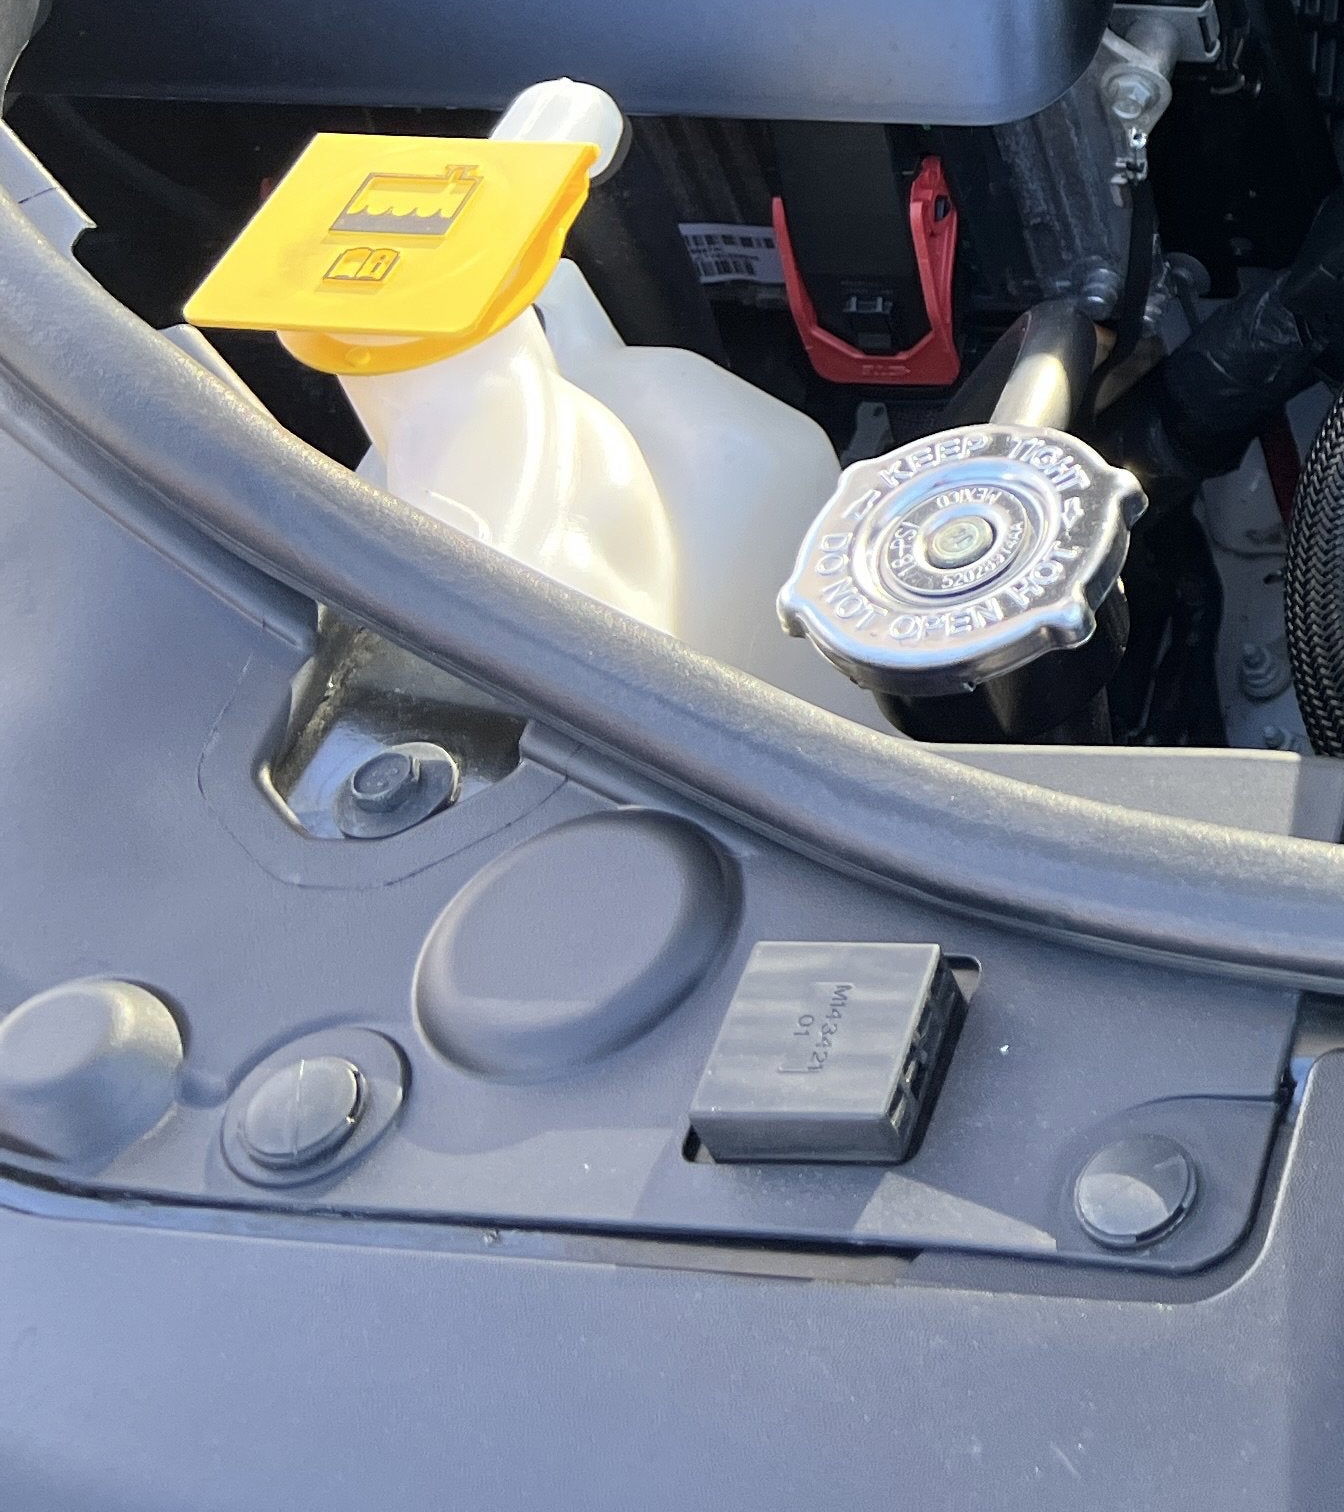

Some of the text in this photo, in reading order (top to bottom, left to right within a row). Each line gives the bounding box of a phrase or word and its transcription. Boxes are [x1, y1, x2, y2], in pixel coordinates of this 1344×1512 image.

[879, 434, 1091, 492] KEEP TIGHT
[936, 487, 1003, 509] MEXICO
[814, 531, 1081, 641] DO NOT OPEN HOT
